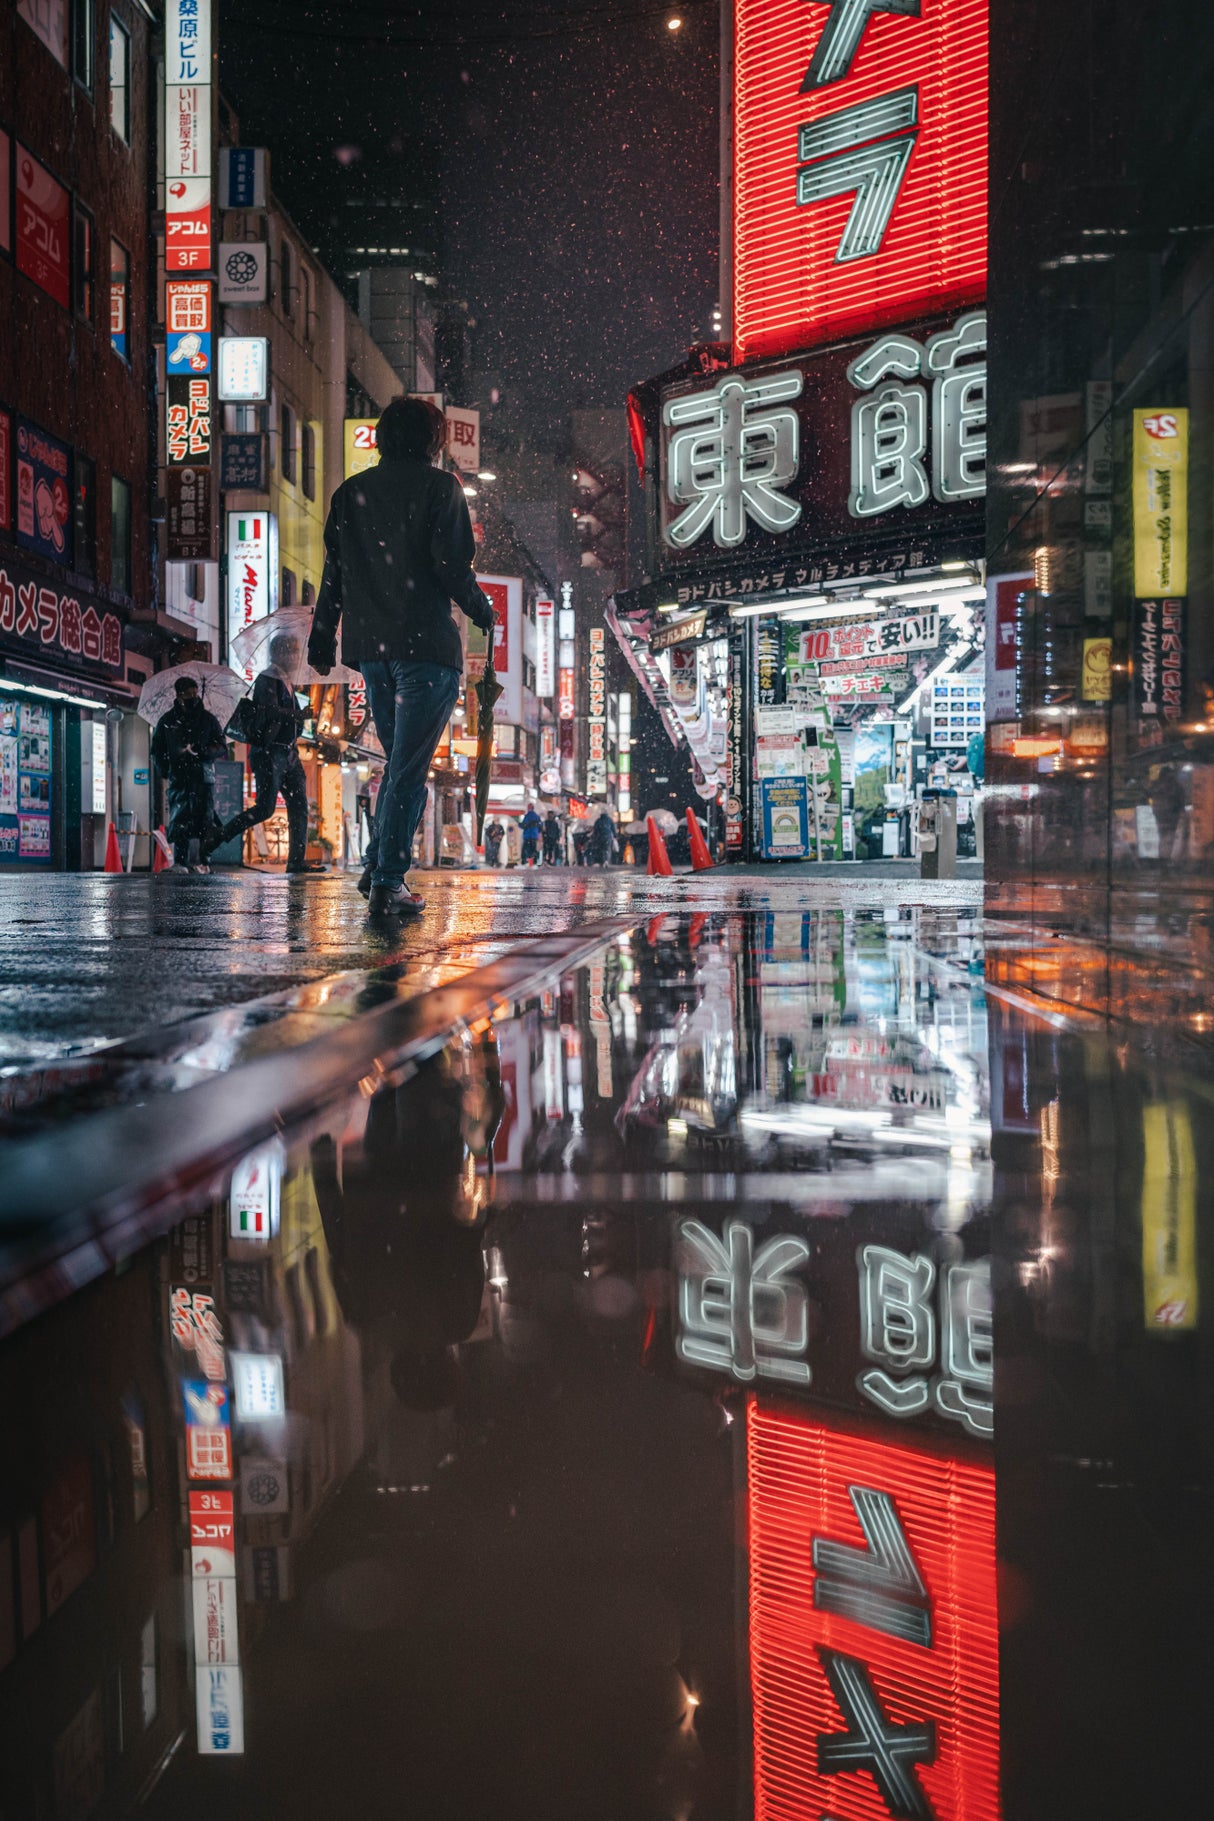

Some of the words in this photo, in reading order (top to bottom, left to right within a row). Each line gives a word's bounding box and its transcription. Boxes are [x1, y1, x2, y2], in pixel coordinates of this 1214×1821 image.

[179, 0, 198, 79] 桑原ビル
[179, 87, 192, 174] いい部屋ネット
[24, 206, 61, 264] アコム
[168, 221, 209, 235] アコム
[178, 252, 199, 266] 3F
[175, 298, 204, 311] 高価
[175, 314, 204, 327] 買取
[191, 357, 207, 369] 2F
[189, 380, 210, 455] ヨドバシ
[662, 310, 987, 549] 東館
[169, 405, 188, 461] カメラ
[446, 420, 477, 447] 取
[242, 563, 258, 627] Miami
[677, 572, 786, 601] ヨドバシカメラ
[0, 569, 120, 667] カメラ総合館
[881, 615, 935, 650] 安い!!
[652, 620, 702, 649] ヨドバシカメラ
[833, 624, 874, 643] ポイント
[866, 640, 877, 652] で
[840, 641, 864, 656] 還元
[589, 628, 605, 716] ヨドバシカメラ
[841, 675, 885, 694] チェキ
